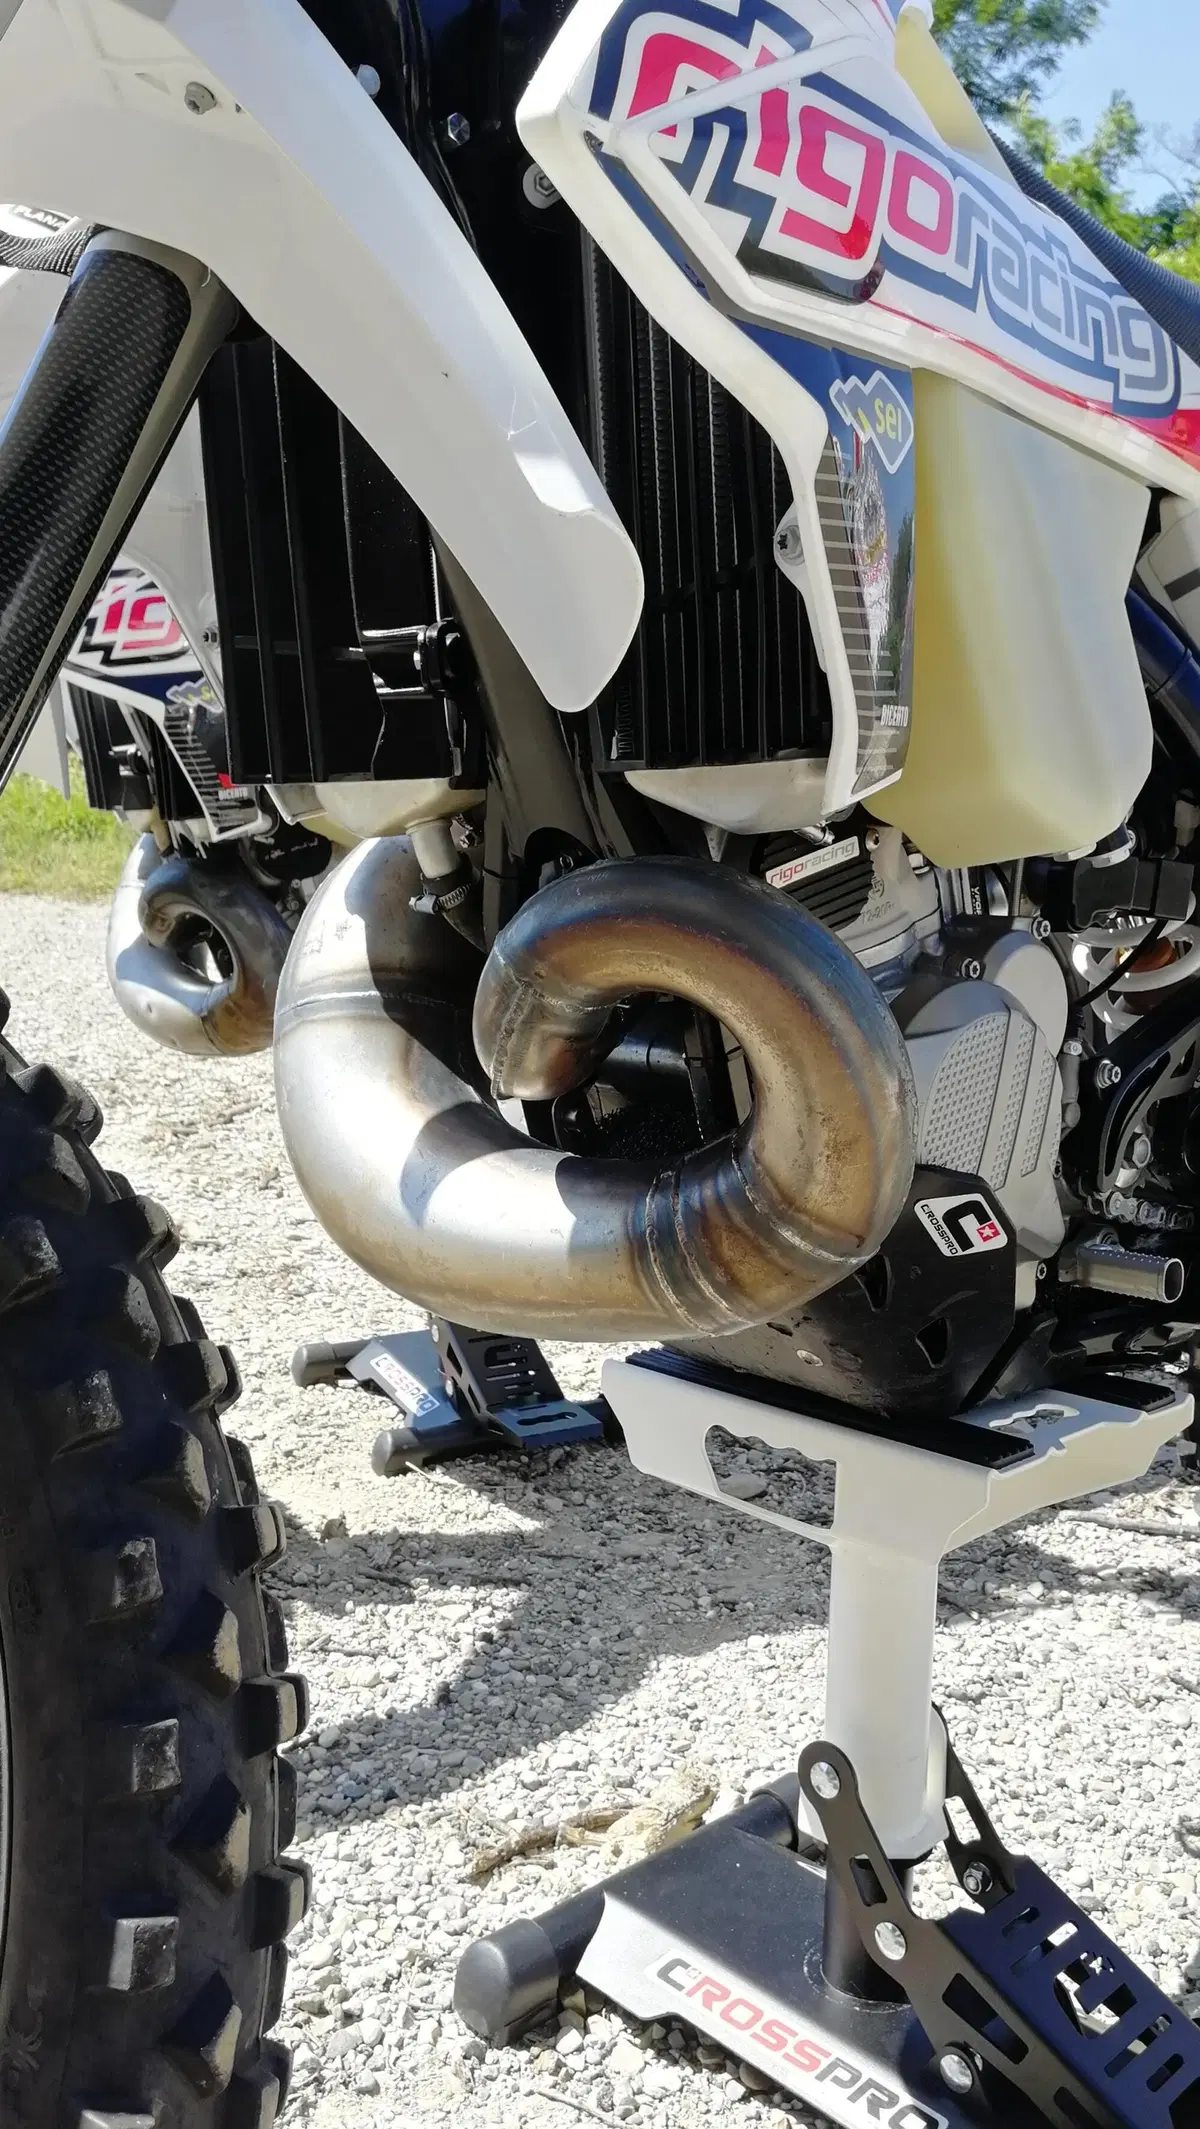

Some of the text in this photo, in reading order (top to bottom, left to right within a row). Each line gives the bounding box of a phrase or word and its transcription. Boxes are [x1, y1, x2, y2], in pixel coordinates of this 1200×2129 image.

[770, 842, 855, 884] rigoracing
[920, 1204, 959, 1256] CROSSPRO
[657, 1957, 940, 2129] CROSSPRO
